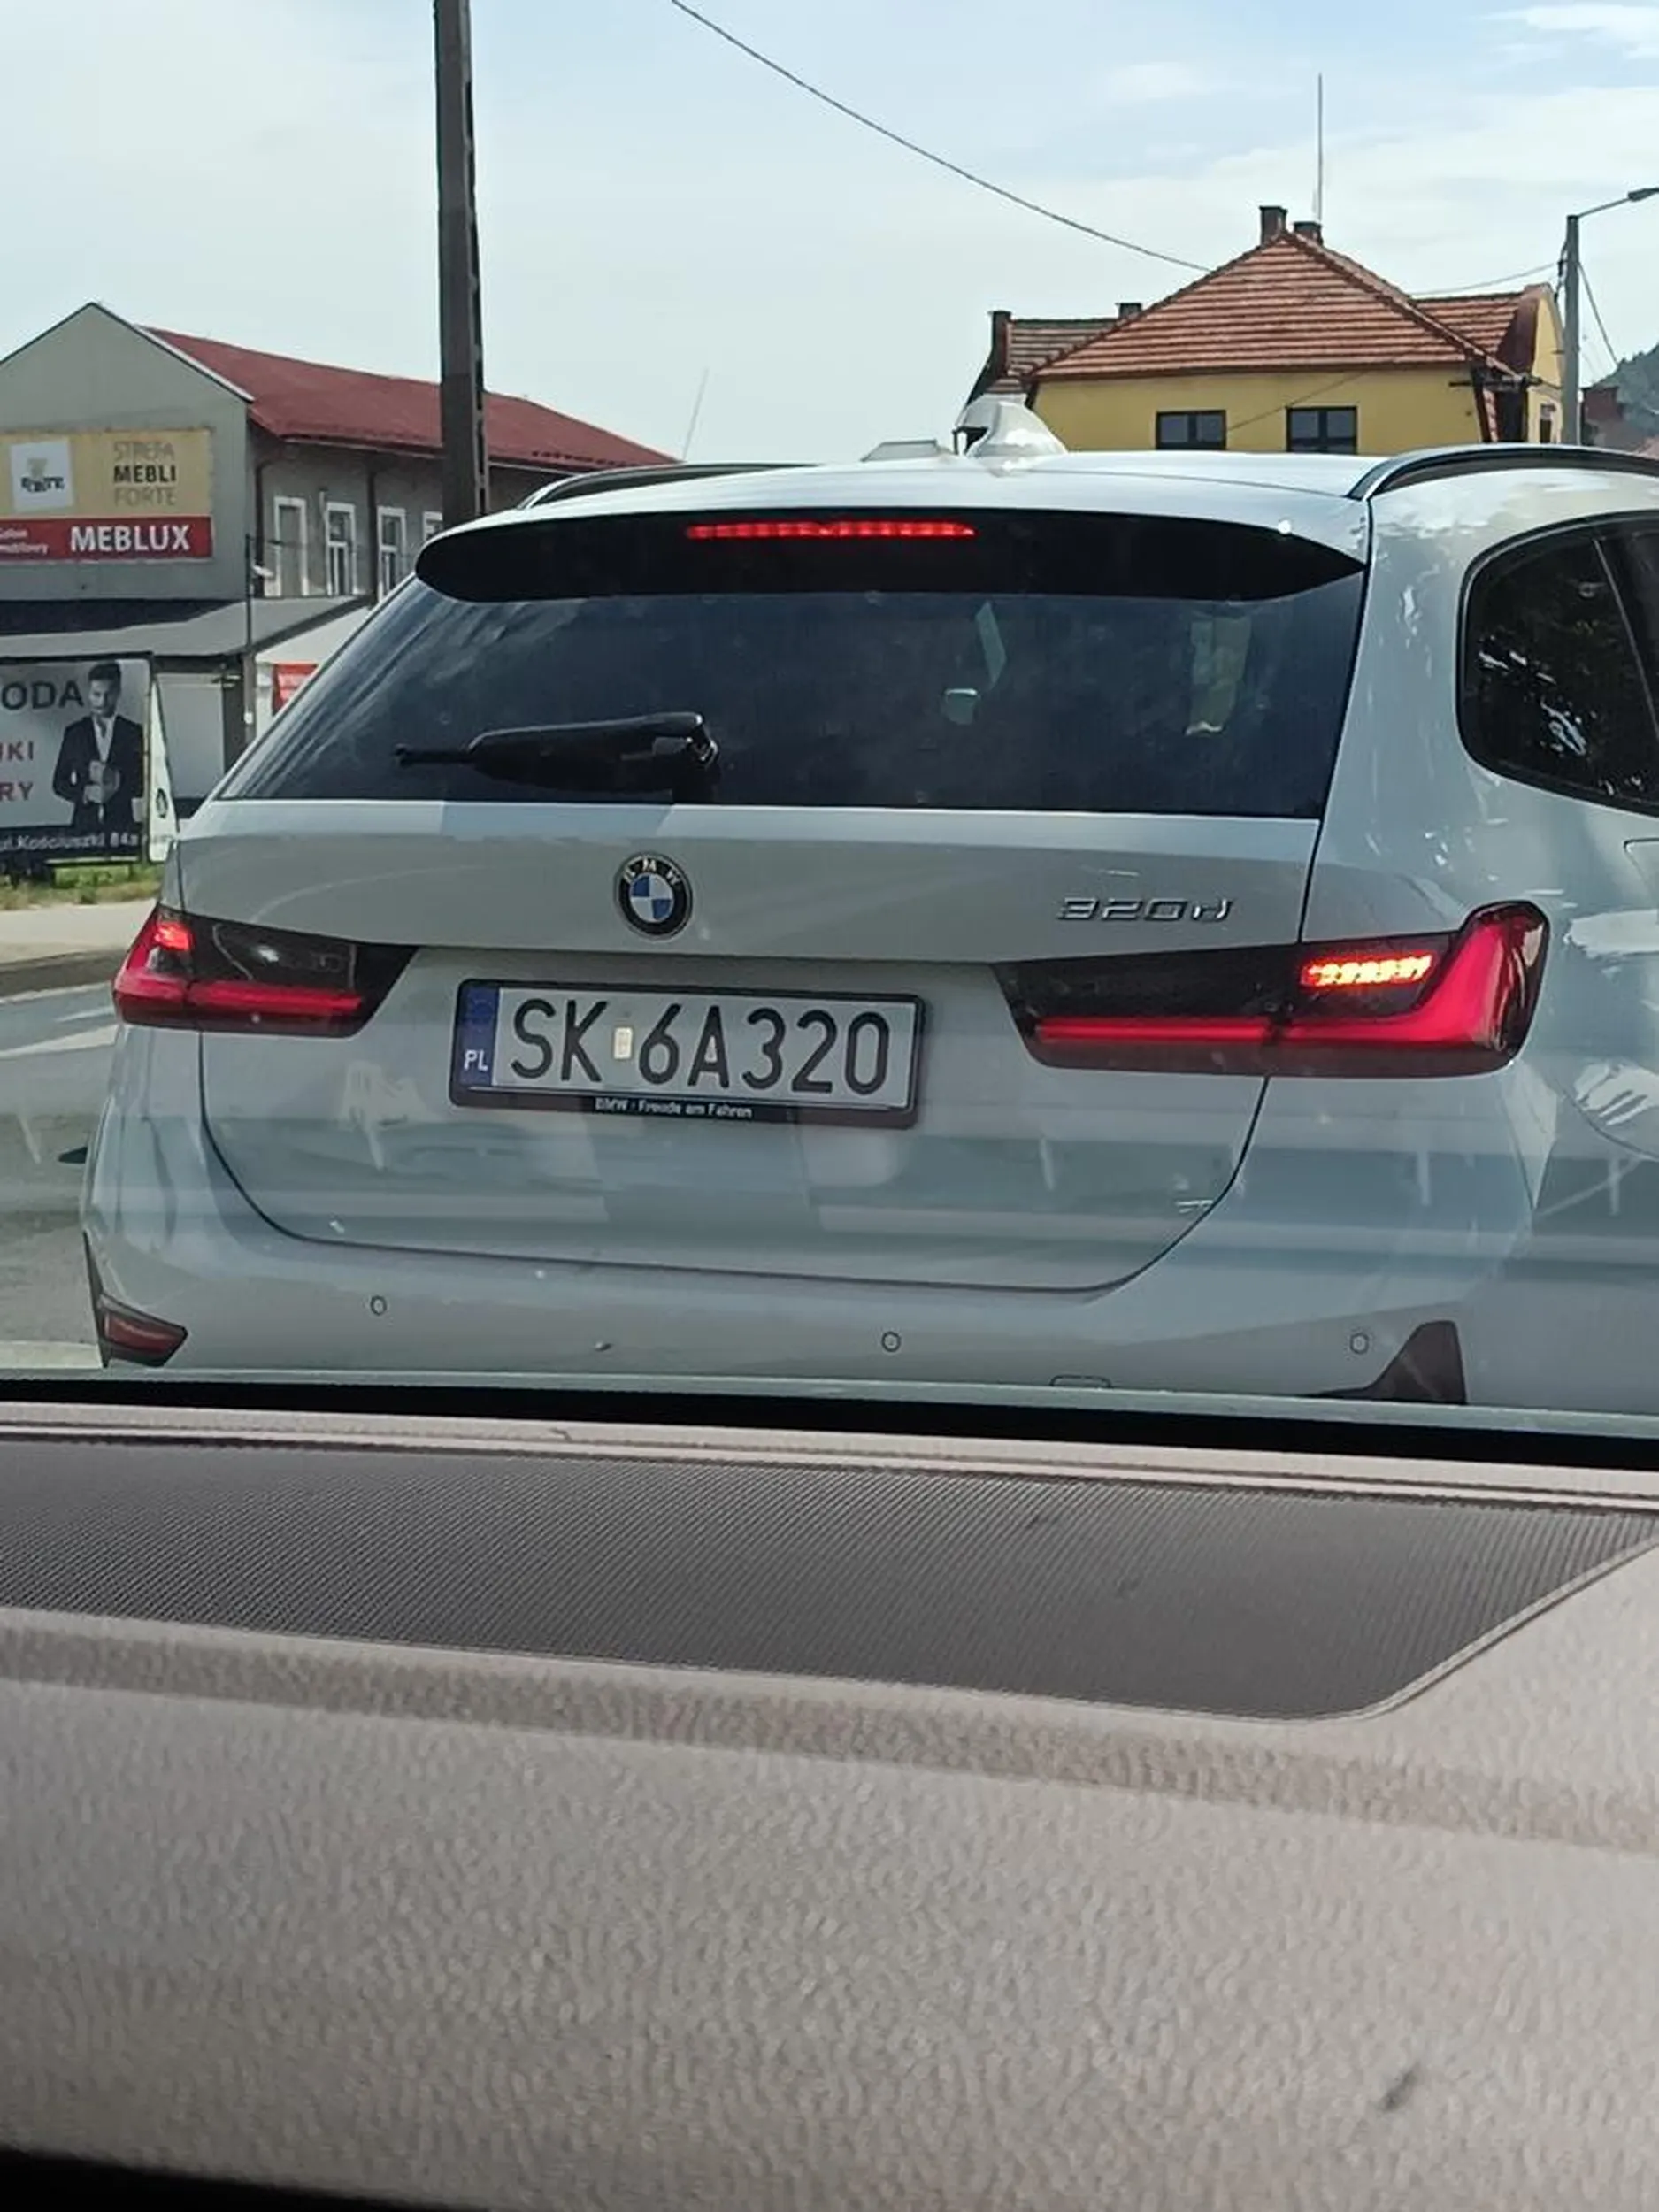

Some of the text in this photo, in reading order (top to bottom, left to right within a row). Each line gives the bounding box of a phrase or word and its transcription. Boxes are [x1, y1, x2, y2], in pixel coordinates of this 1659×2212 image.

[113, 465, 176, 483] MEBLI
[70, 524, 190, 553] MEBLUX
[1058, 896, 1233, 921] 320d
[511, 998, 890, 1096] SK 6A320
[463, 1048, 489, 1072] PL
